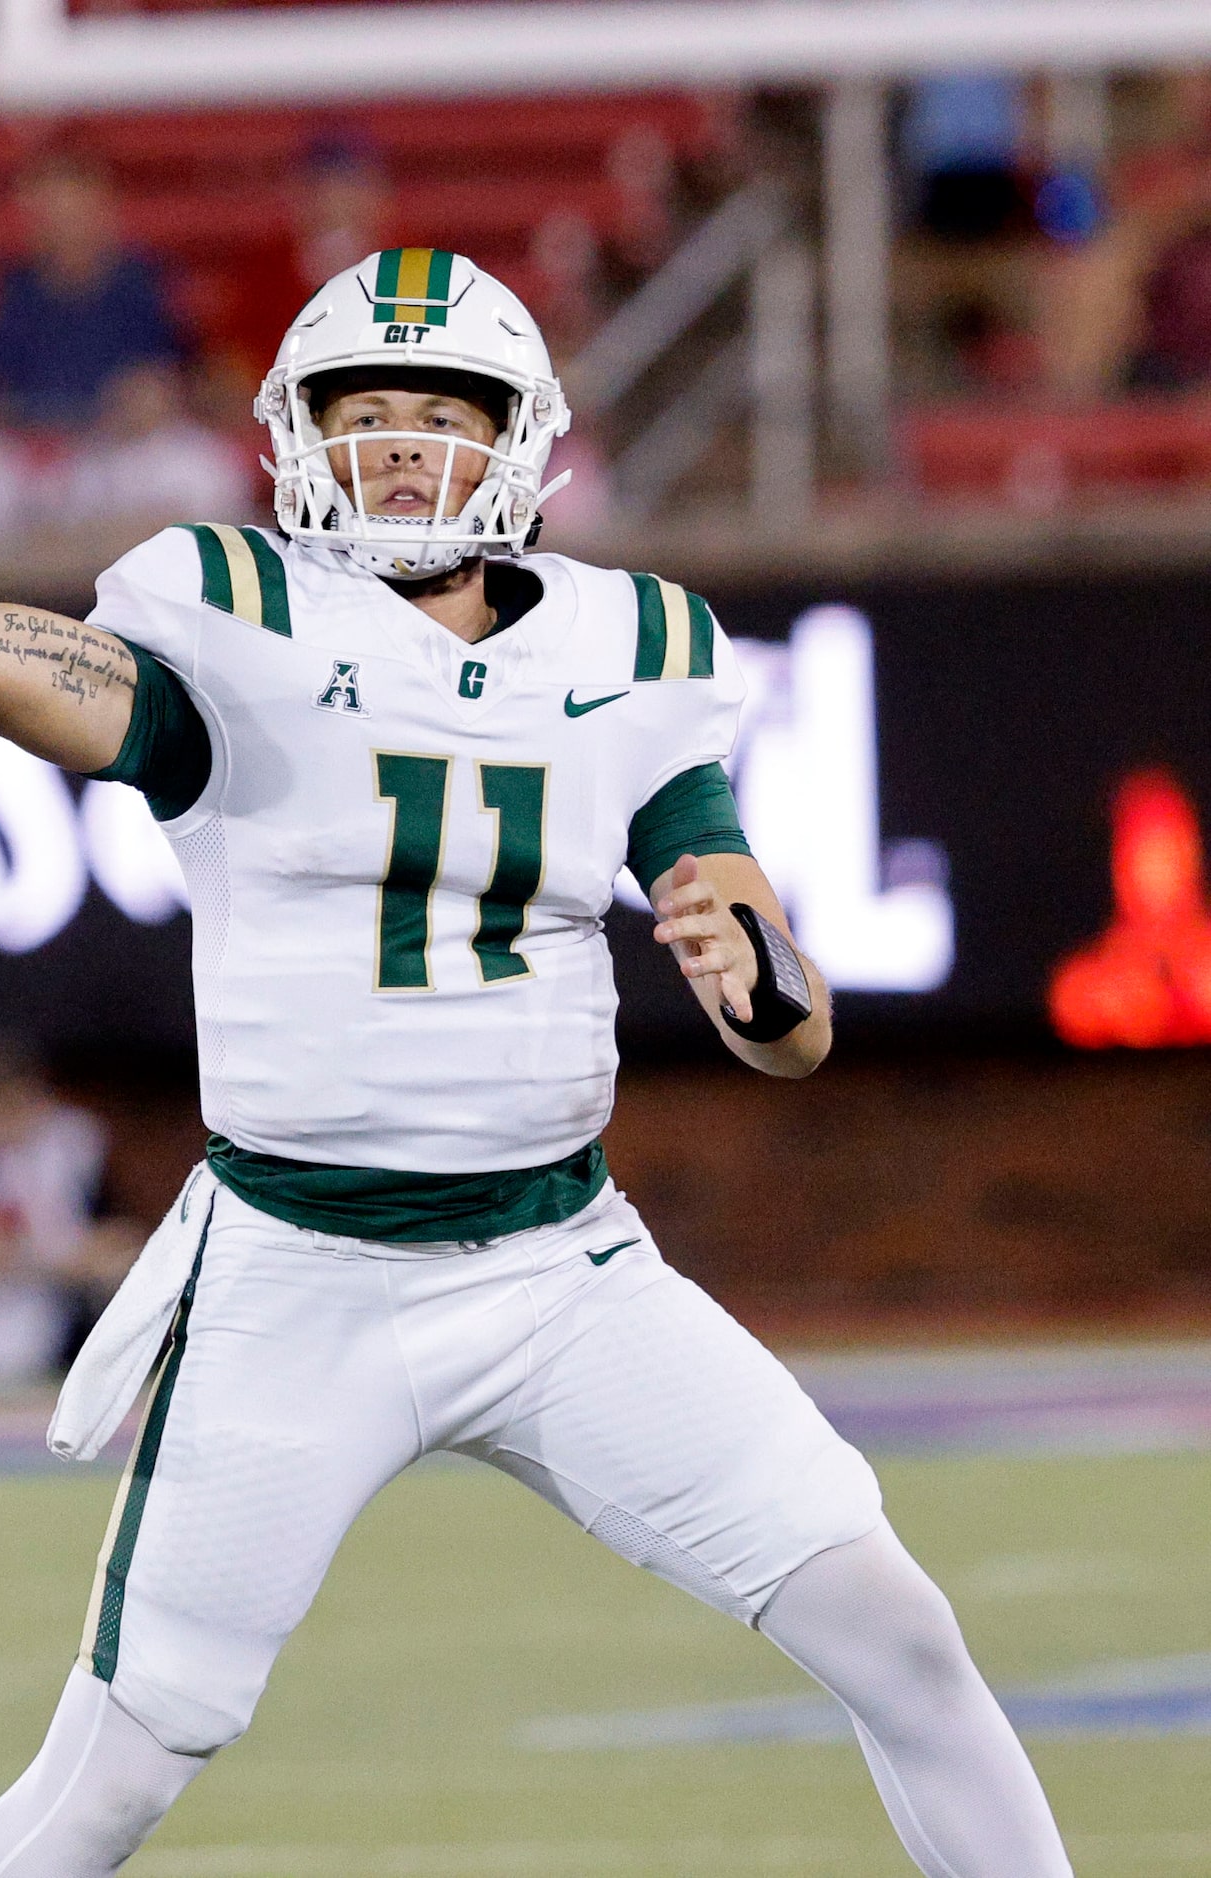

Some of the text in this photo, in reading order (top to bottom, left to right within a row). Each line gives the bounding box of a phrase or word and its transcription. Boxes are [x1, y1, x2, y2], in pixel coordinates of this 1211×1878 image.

[4, 613, 26, 632] For
[28, 616, 48, 641] God
[369, 748, 551, 994] 11
